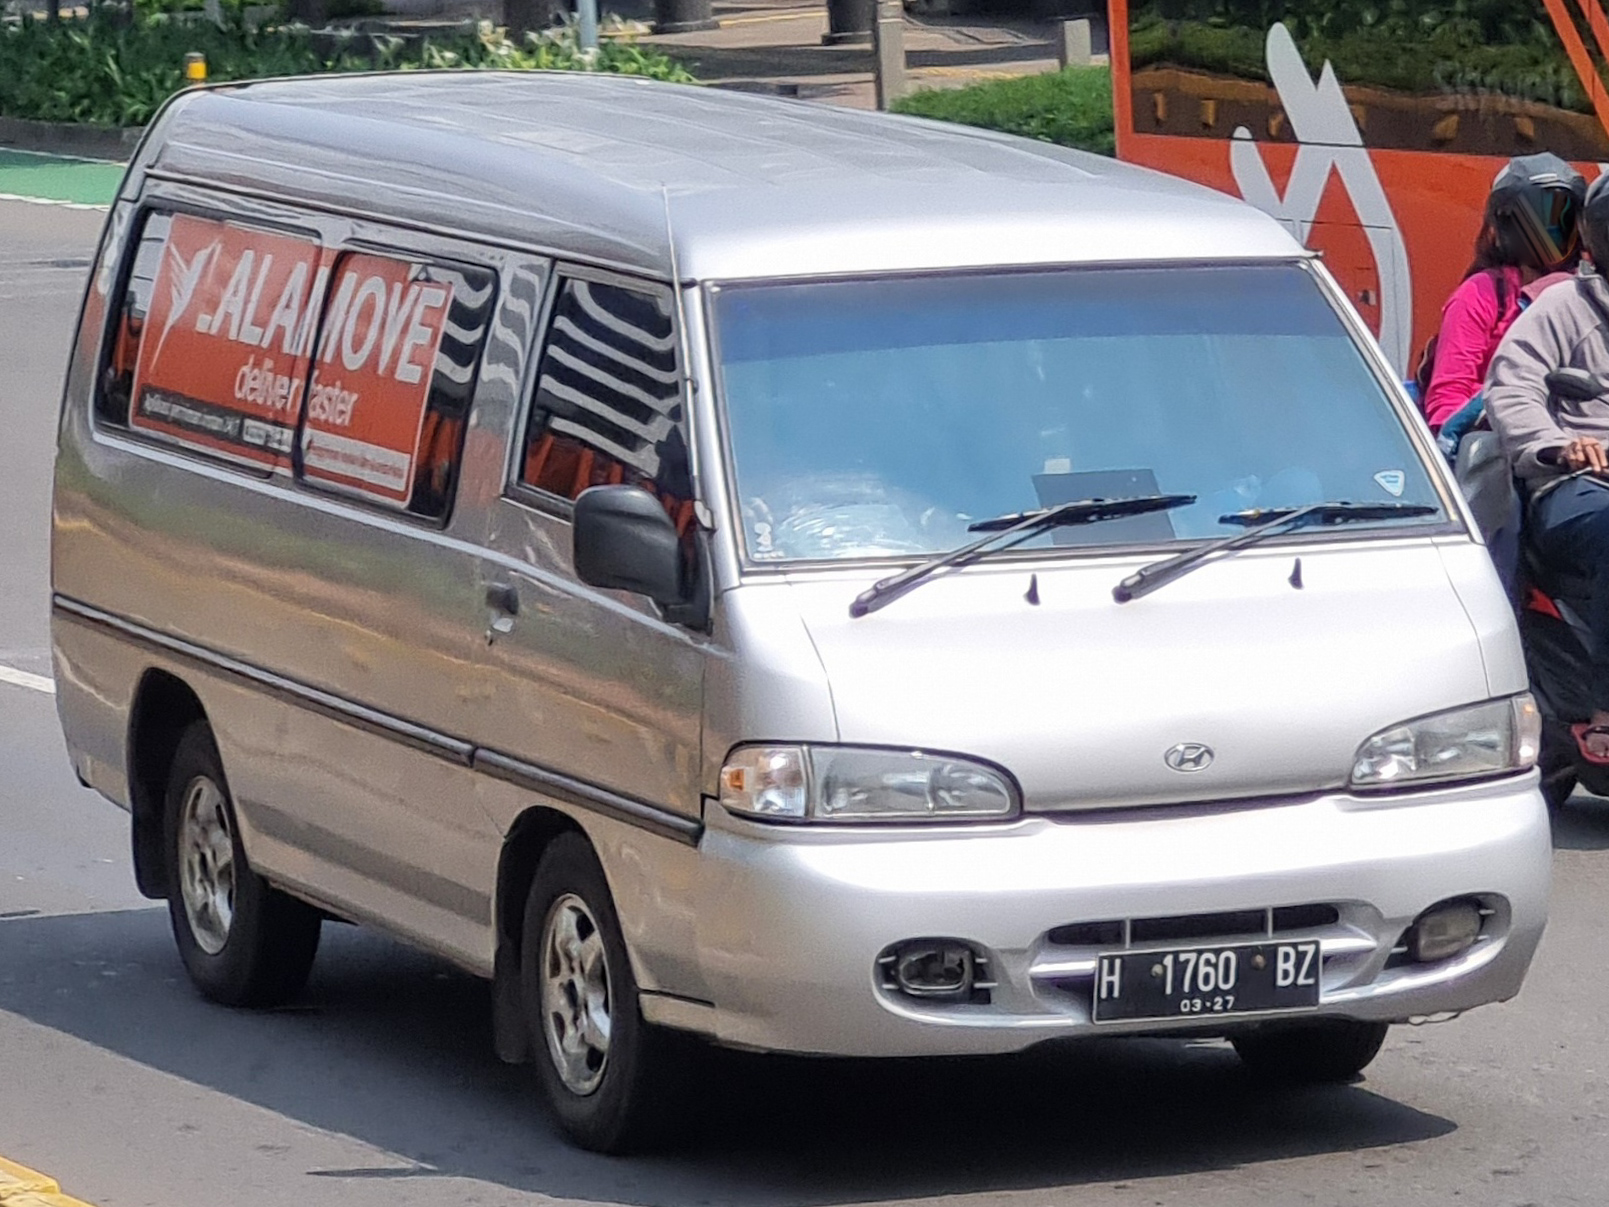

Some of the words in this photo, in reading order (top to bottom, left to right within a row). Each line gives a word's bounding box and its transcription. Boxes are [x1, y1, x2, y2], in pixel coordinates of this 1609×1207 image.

[234, 354, 300, 412] deliver
[1100, 958, 1121, 999] H
[1162, 950, 1237, 995] 1760
[1276, 944, 1316, 987] BZ
